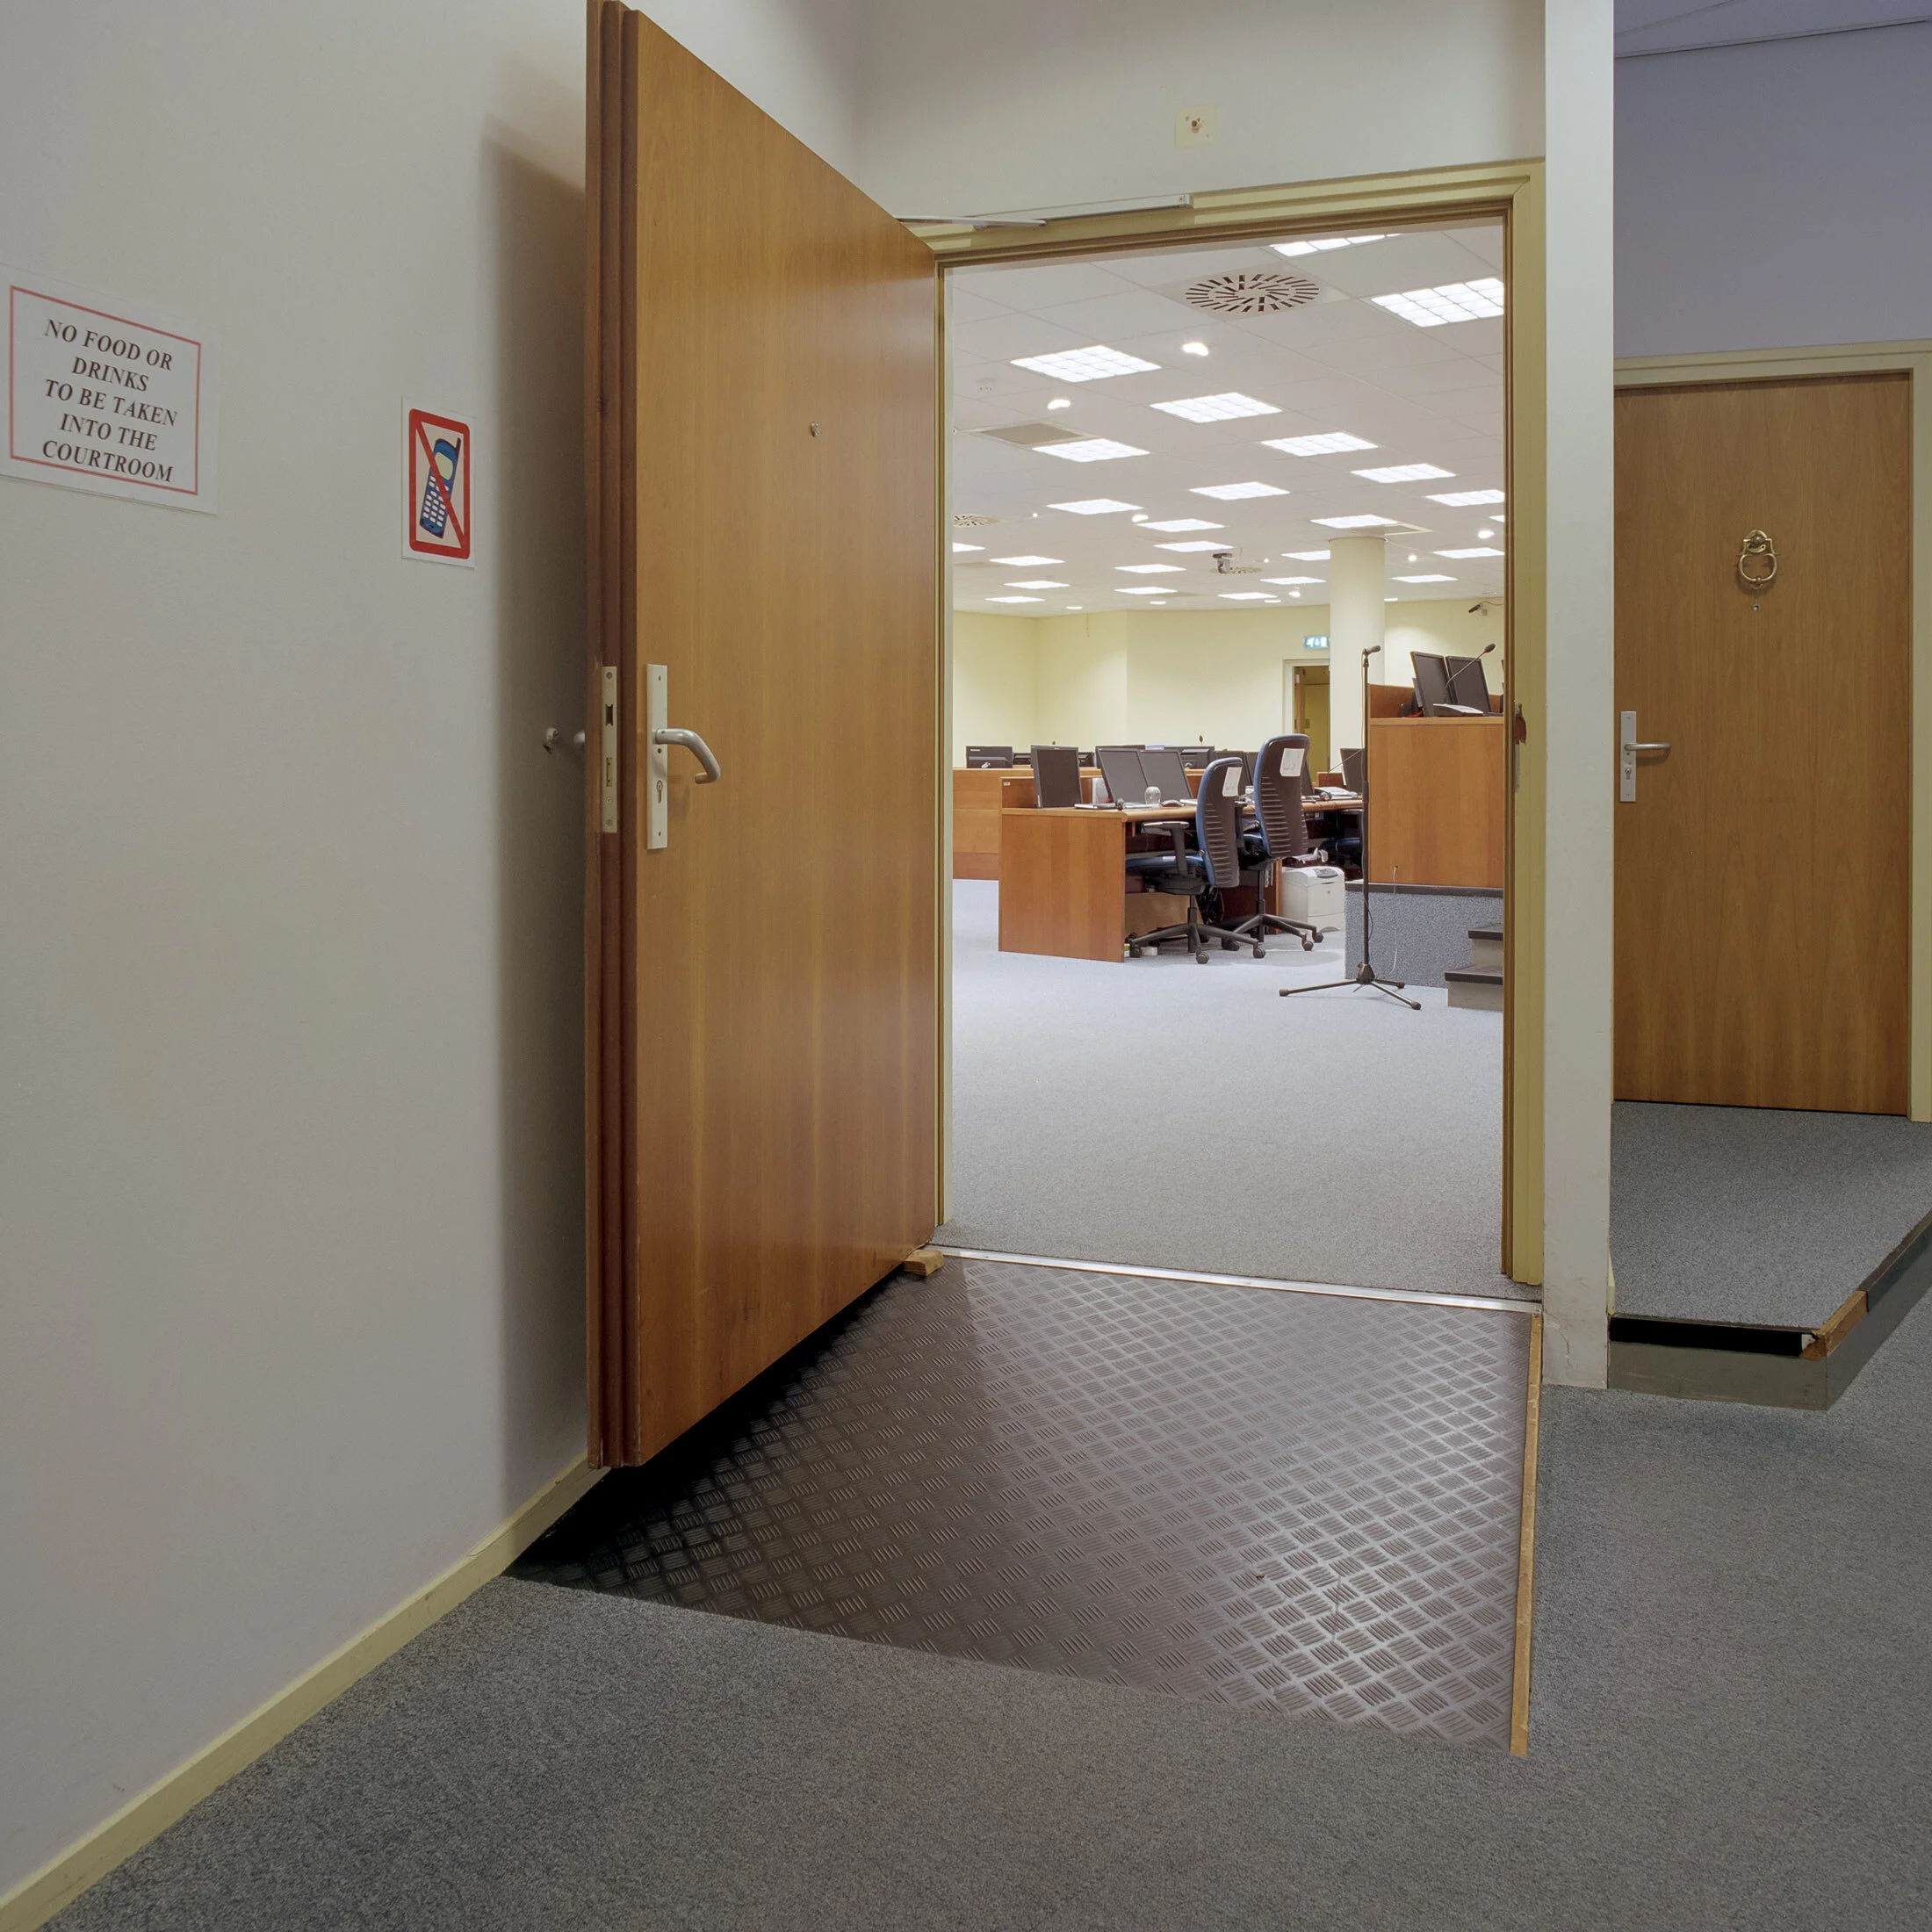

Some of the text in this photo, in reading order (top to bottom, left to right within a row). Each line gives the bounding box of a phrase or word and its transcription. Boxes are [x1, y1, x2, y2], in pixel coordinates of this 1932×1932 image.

[44, 319, 173, 371] NO FOOD OR
[71, 356, 149, 392] DRINKS
[45, 378, 178, 427] TO BE TAKEN
[59, 413, 158, 451] INTO THE
[42, 440, 174, 482] COURTROOM
